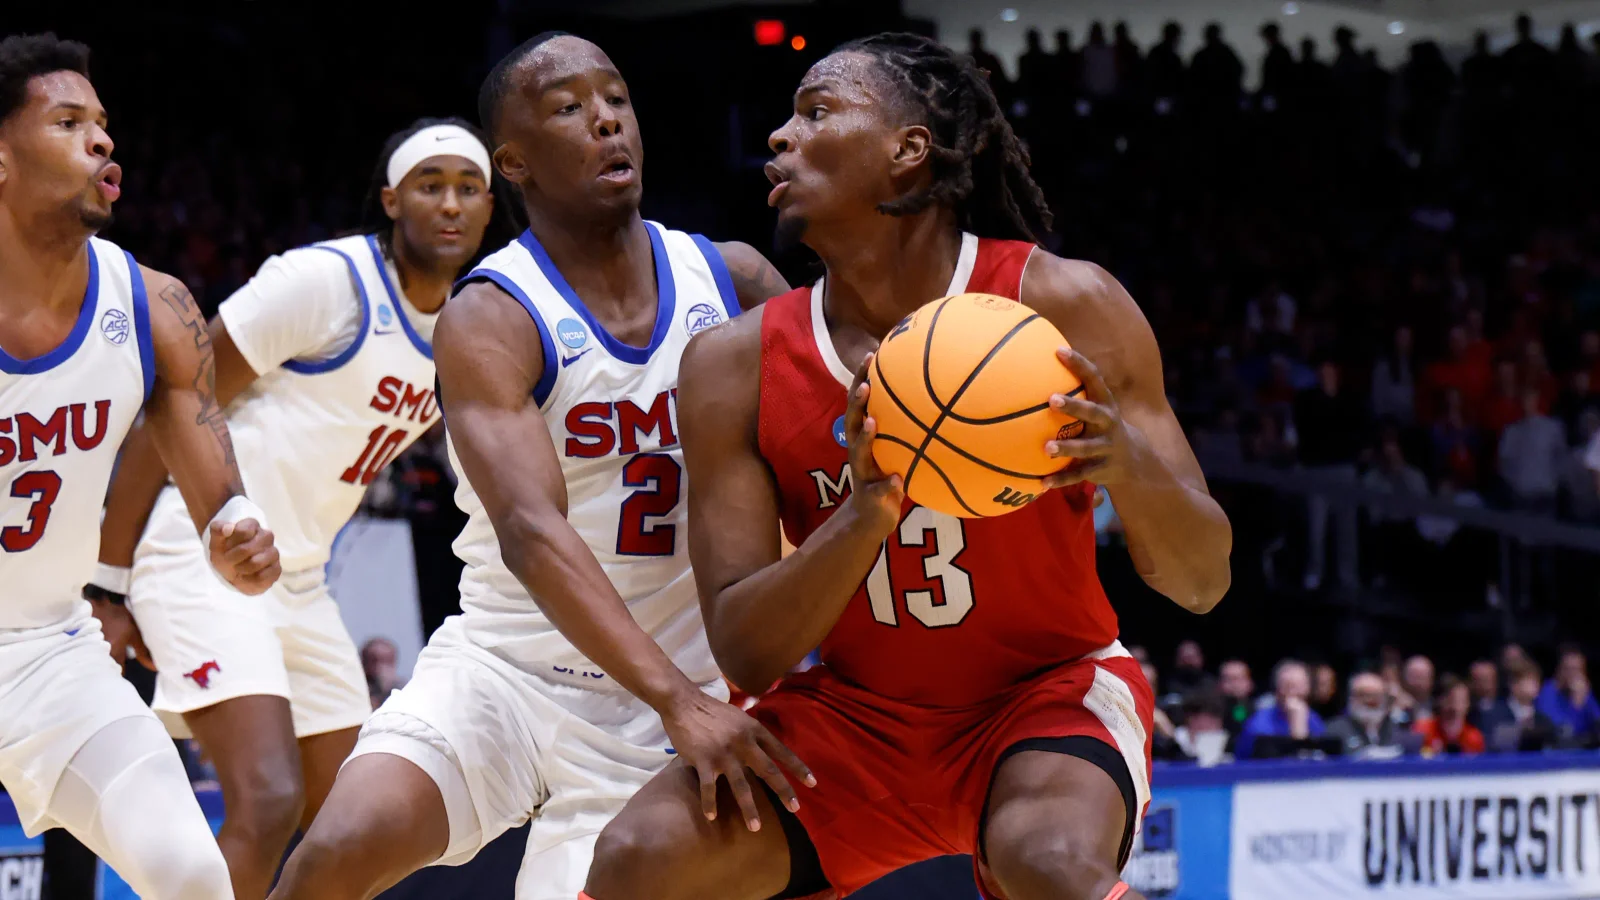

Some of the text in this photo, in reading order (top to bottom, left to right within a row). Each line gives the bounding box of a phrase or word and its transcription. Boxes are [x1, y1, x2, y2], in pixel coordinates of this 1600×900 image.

[104, 319, 129, 332] ACC
[562, 330, 586, 341] NCAA
[691, 315, 720, 331] ACC
[369, 375, 438, 425] SMU
[565, 387, 677, 458] SM
[339, 424, 408, 486] 10
[0, 470, 62, 552] 3
[616, 453, 681, 556] 2
[1363, 793, 1600, 886] UNIVERSIT
